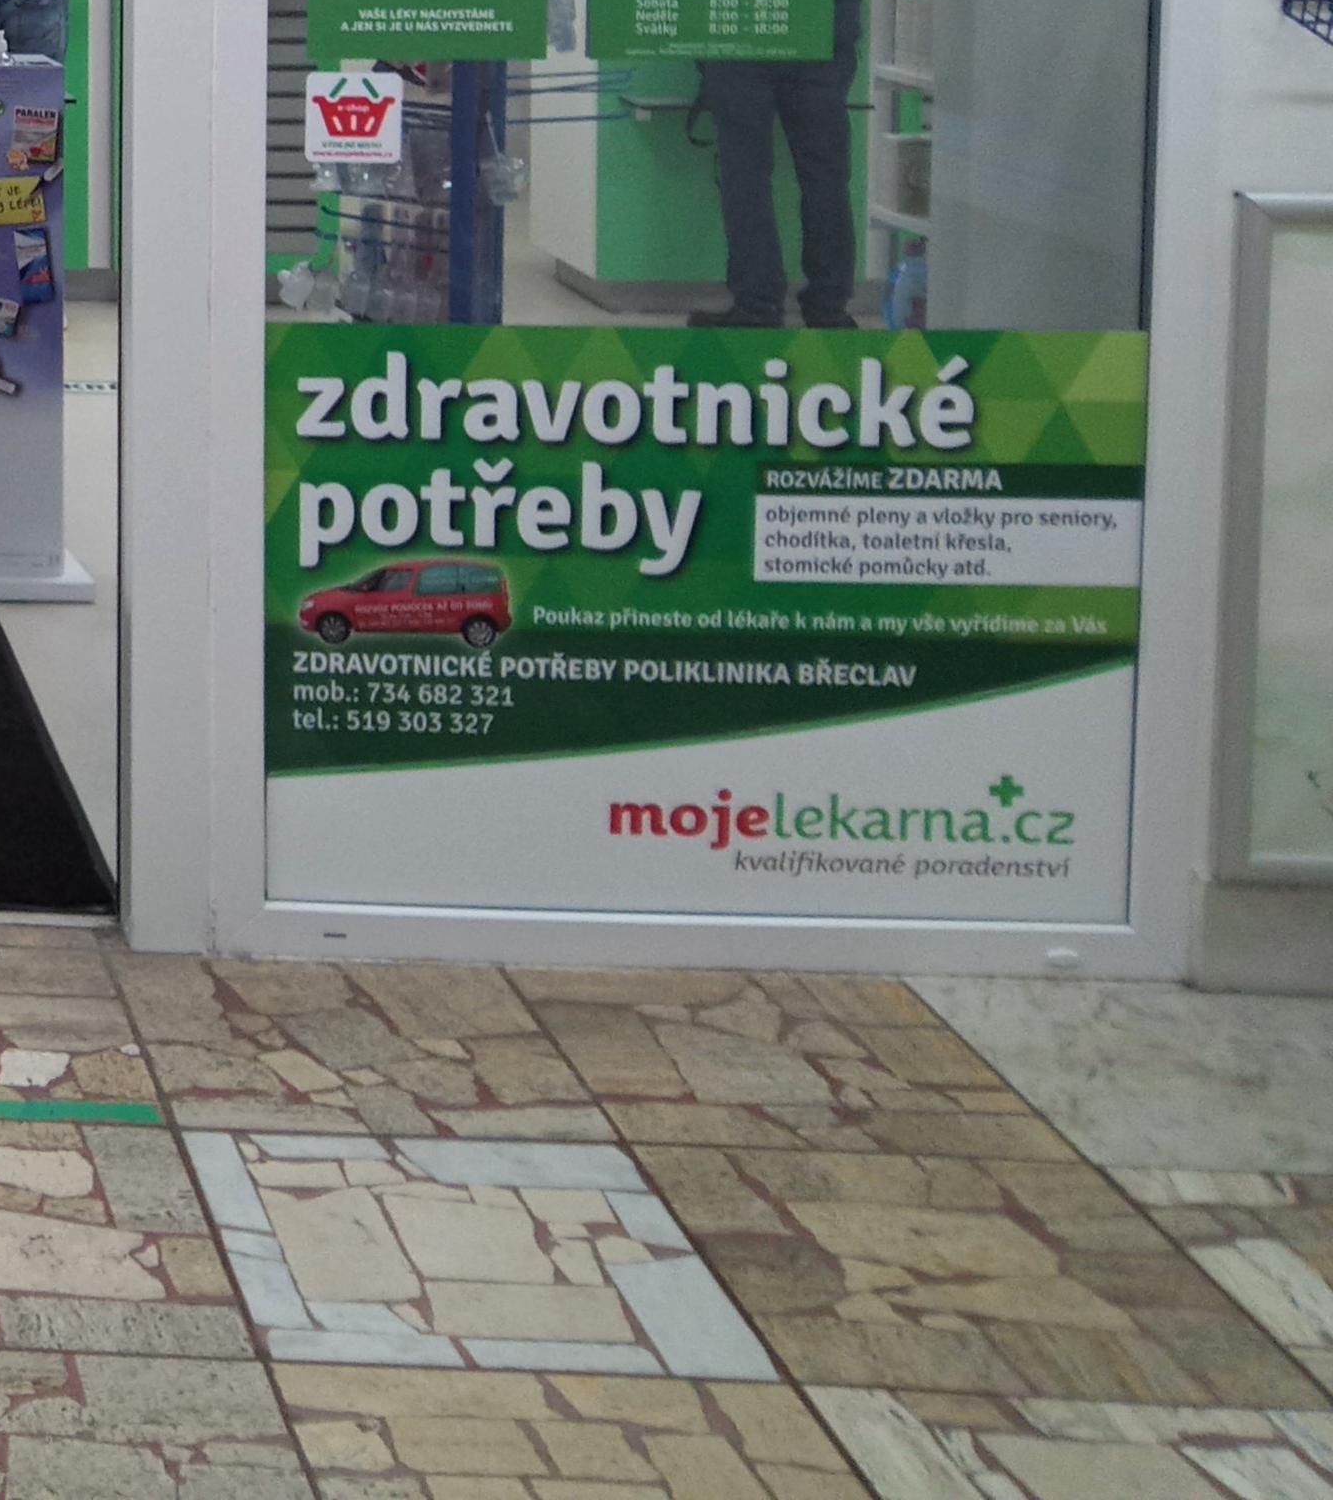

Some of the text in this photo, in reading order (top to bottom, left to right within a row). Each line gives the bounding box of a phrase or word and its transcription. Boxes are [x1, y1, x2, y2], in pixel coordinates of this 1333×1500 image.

[351, 21, 373, 32] JEN
[390, 21, 403, 32] JE
[416, 20, 439, 32] NÁS
[359, 7, 387, 19] VAŠE
[390, 7, 417, 19] LÉKY
[295, 350, 976, 451] zdravotnické
[767, 467, 1004, 491] ROZVÁŽÍME ZDARMA
[297, 457, 702, 576] potřeby
[766, 506, 1118, 531] objemné pleny a vložky pro seniory,
[765, 531, 1012, 553] chodítka, toaletní křesla,
[764, 557, 992, 580] stomické pomůcky atd.
[533, 605, 605, 626] Poukaz
[610, 606, 692, 632] přineste
[698, 608, 723, 628] od
[728, 607, 789, 629] lékaře
[795, 611, 805, 629] k
[812, 612, 855, 631] nám
[861, 618, 872, 631] a
[878, 618, 906, 635] my
[912, 613, 945, 632] vše
[1044, 619, 1065, 634] za
[1073, 615, 1108, 634] Vás
[293, 650, 917, 689] ZDRAVOTNICKÉ POTŘEBY POLIKLINIKA BŘECLAV
[293, 680, 514, 707] mob.: 734 682 321
[293, 708, 494, 735] tel.: 519 303 327
[609, 788, 1076, 850] mojelekarna.cz
[734, 847, 1071, 880] kvalifikované poradenství
